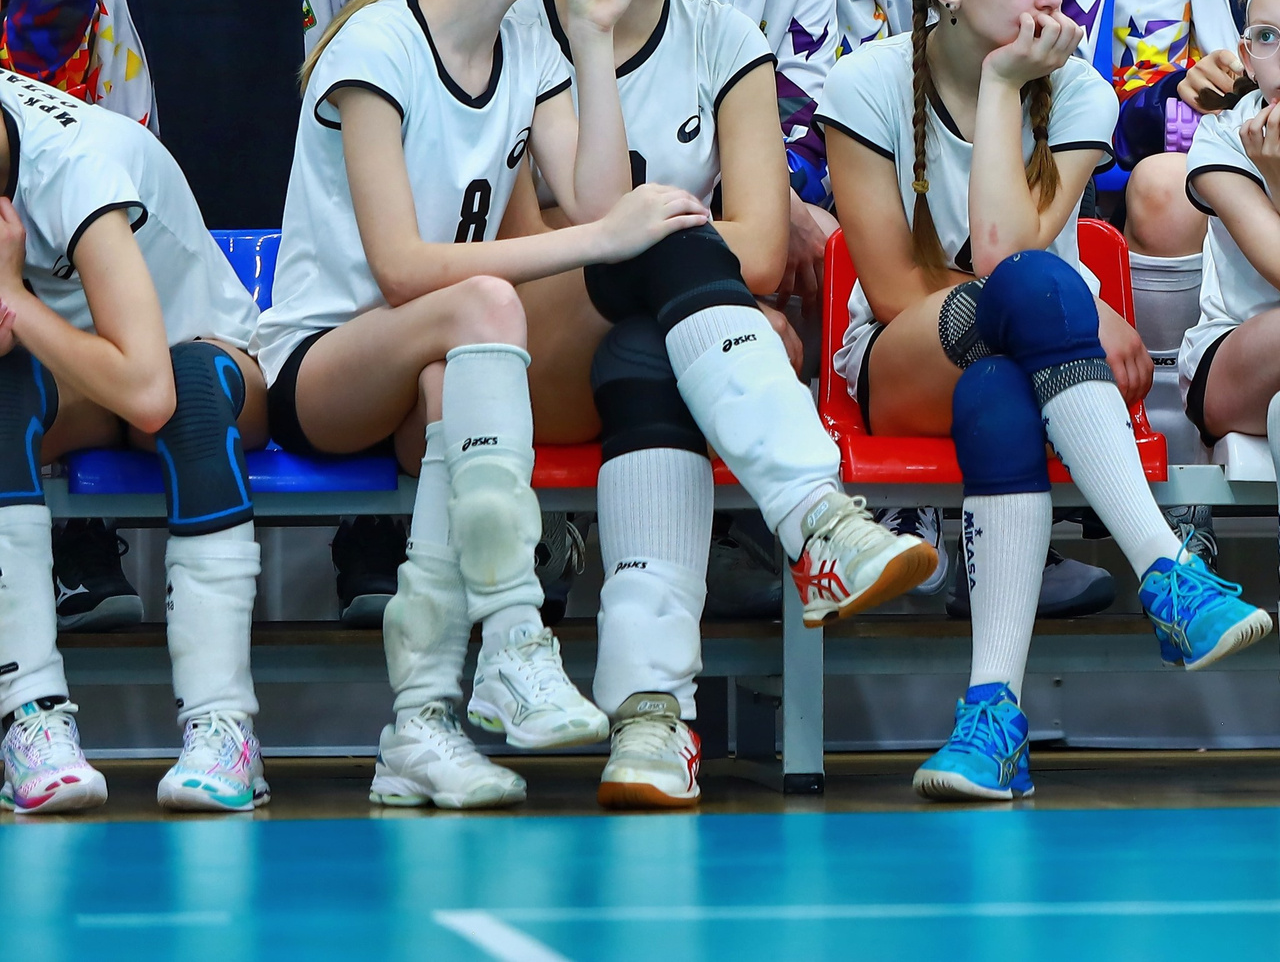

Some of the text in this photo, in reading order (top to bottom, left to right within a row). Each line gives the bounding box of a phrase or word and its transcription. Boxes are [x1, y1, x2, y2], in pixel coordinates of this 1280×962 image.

[0, 69, 79, 109] ОБЛА
[453, 178, 492, 244] 8
[964, 510, 977, 592] MIKASA
